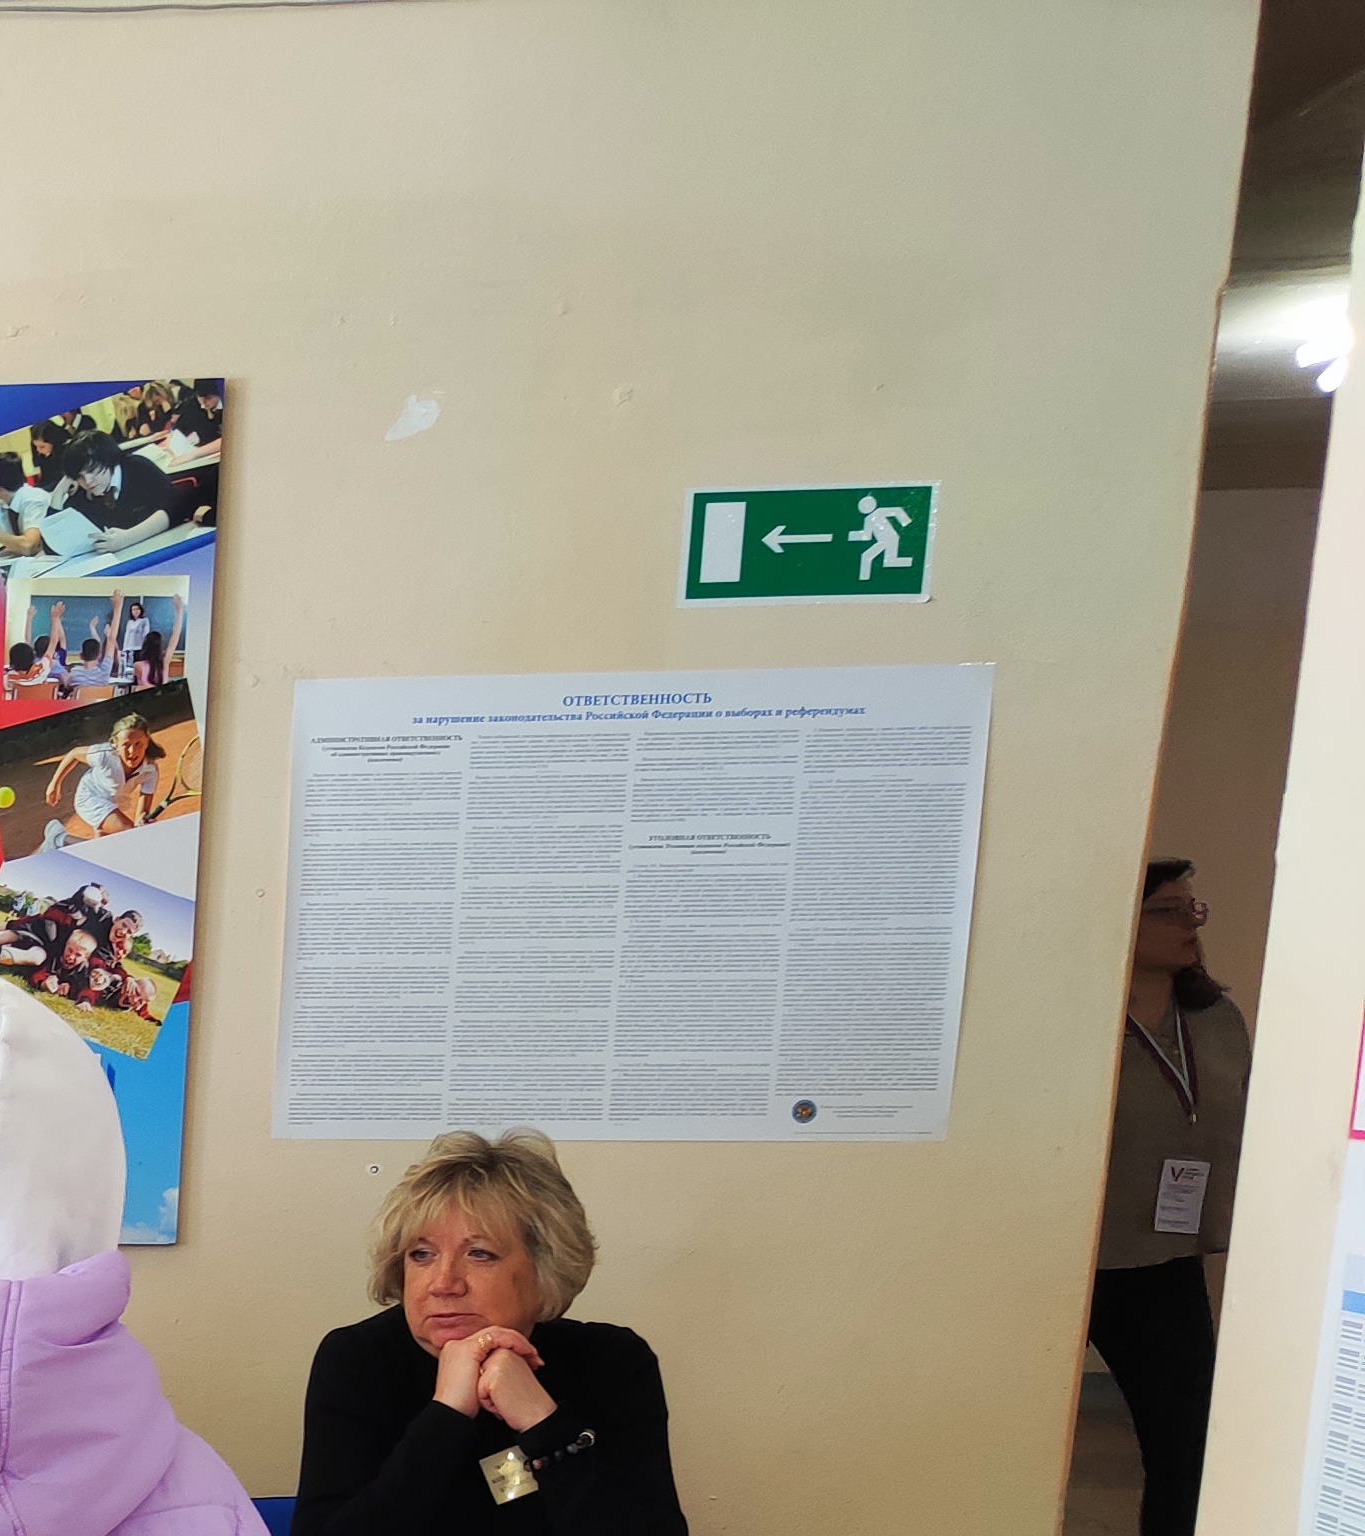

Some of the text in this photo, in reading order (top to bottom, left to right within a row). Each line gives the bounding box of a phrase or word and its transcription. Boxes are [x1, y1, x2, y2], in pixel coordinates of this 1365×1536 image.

[562, 693, 712, 707] ОТВЕТСТВЕННОСТЬ
[426, 714, 485, 726] нарушение
[488, 712, 582, 723] законодательства
[586, 709, 649, 721] Российской
[651, 709, 713, 721] Федерации
[725, 707, 773, 719] выборах
[785, 706, 866, 718] референдумах
